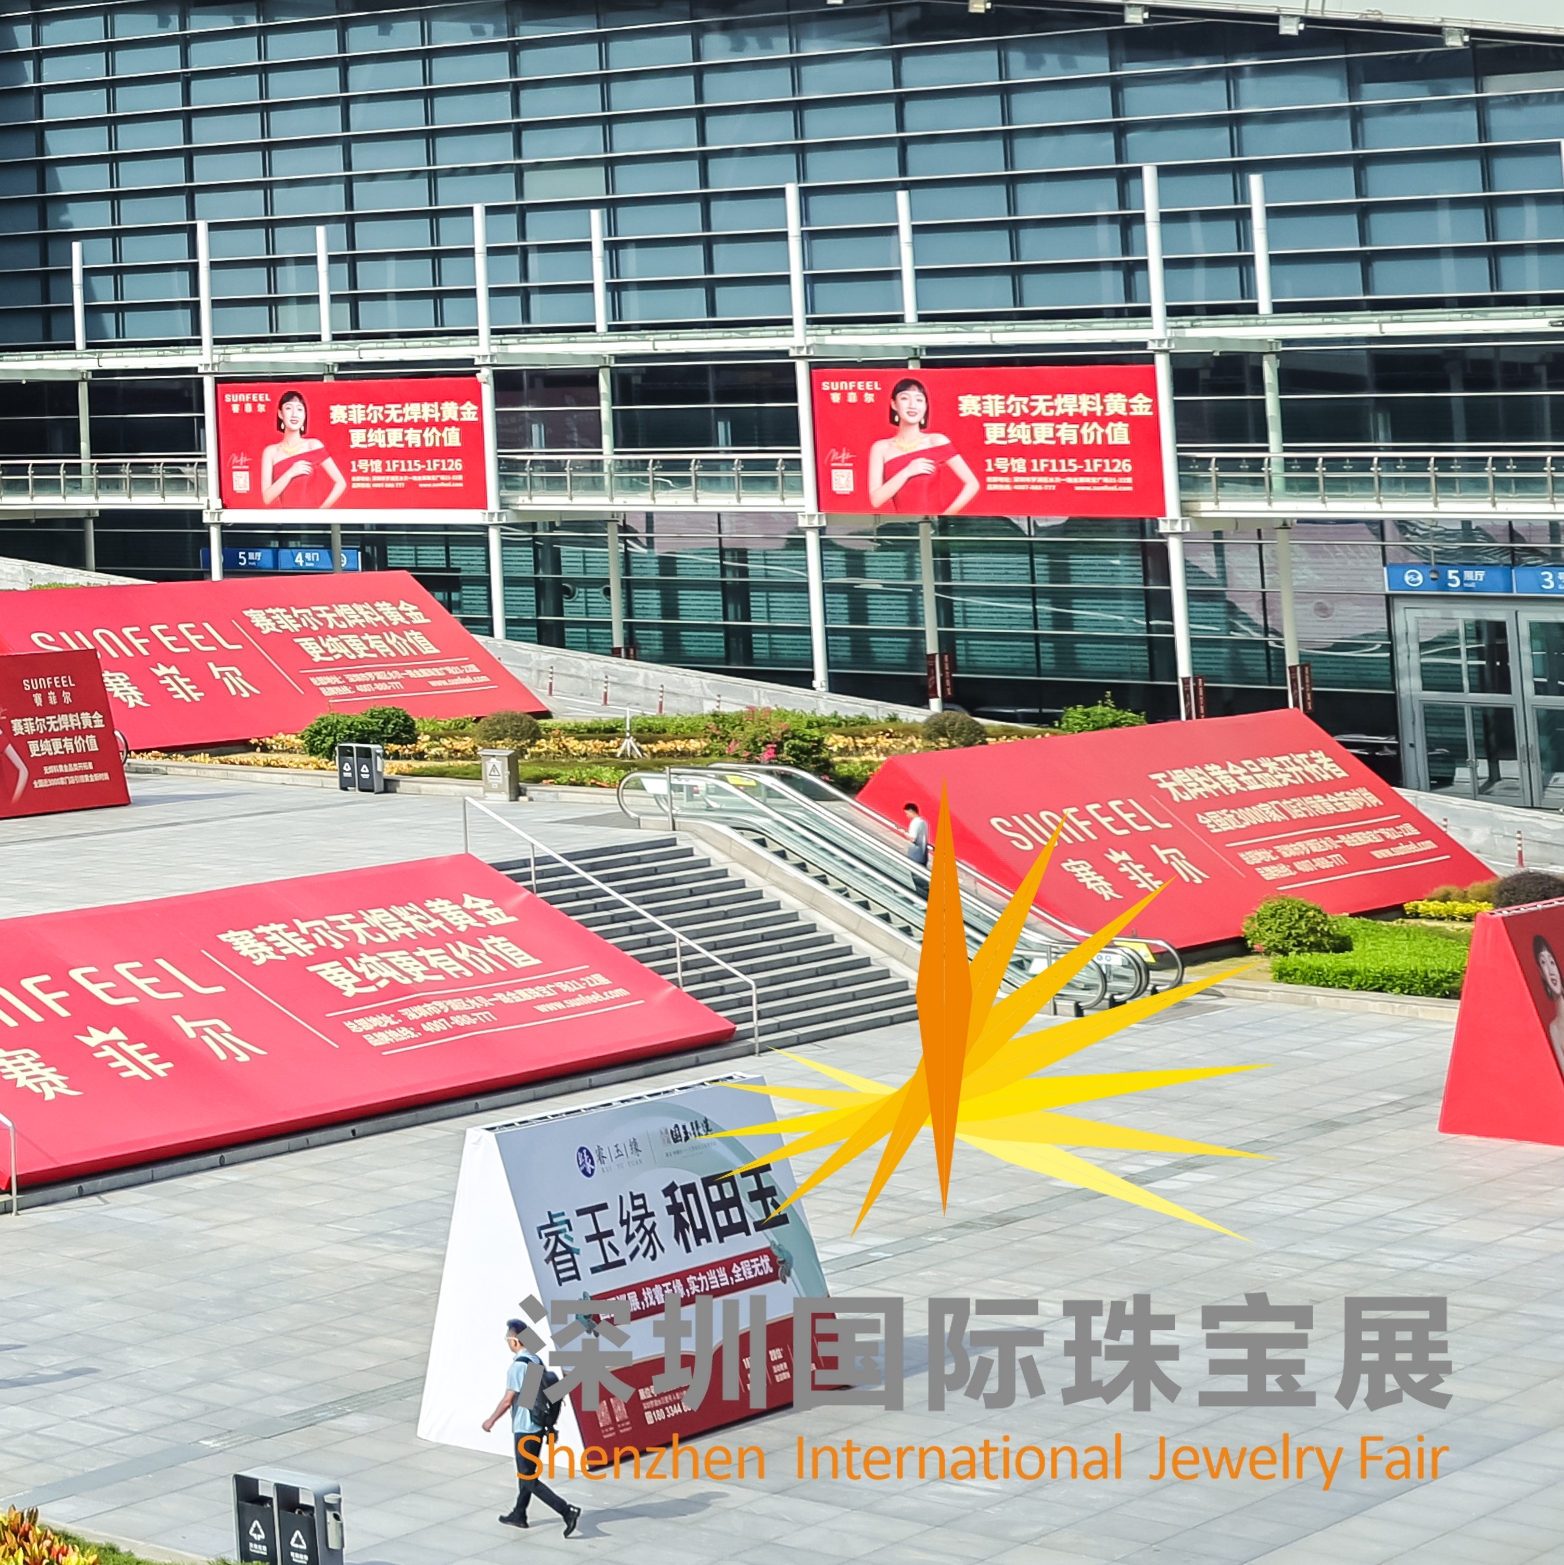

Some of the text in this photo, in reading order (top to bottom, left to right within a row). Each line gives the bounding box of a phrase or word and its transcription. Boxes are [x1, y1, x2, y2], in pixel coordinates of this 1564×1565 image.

[225, 393, 271, 403] SUNFEEL
[822, 381, 881, 391] SUNFEEL
[329, 400, 479, 425] 赛菲尔无焊料黄金
[958, 393, 1153, 418] 赛菲尔无焊料黄金
[349, 426, 461, 448] 更纯更有价值
[983, 422, 1130, 446] 更纯更有价值
[350, 459, 463, 473] 1号馆 1F115-1F126
[985, 458, 1132, 474] 1号馆 1F115-1F126
[238, 551, 247, 566] 5
[294, 551, 304, 567] 4
[1447, 569, 1486, 588] 5 展厅
[1540, 571, 1555, 590] 3
[242, 599, 432, 635] 赛菲尔无焊料黄金
[293, 629, 440, 663] 更纯更有价值
[23, 675, 75, 691] SUNFEEL
[33, 690, 73, 707] 赛菲尔
[11, 711, 105, 737] 赛菲尔无焊料黄金
[27, 735, 100, 758] 更纯更有价值
[1148, 749, 1350, 803] 无焊料黄金品类开拓者
[989, 794, 1174, 853] SUNFEEL
[1059, 842, 1211, 904] 赛菲尔
[219, 892, 520, 967] 赛菲尔无焊料黄金
[306, 935, 543, 999] 更纯更有价值
[533, 986, 631, 1014] www.sunfeel.com
[535, 1163, 790, 1287] 睿玉缘 和田玉
